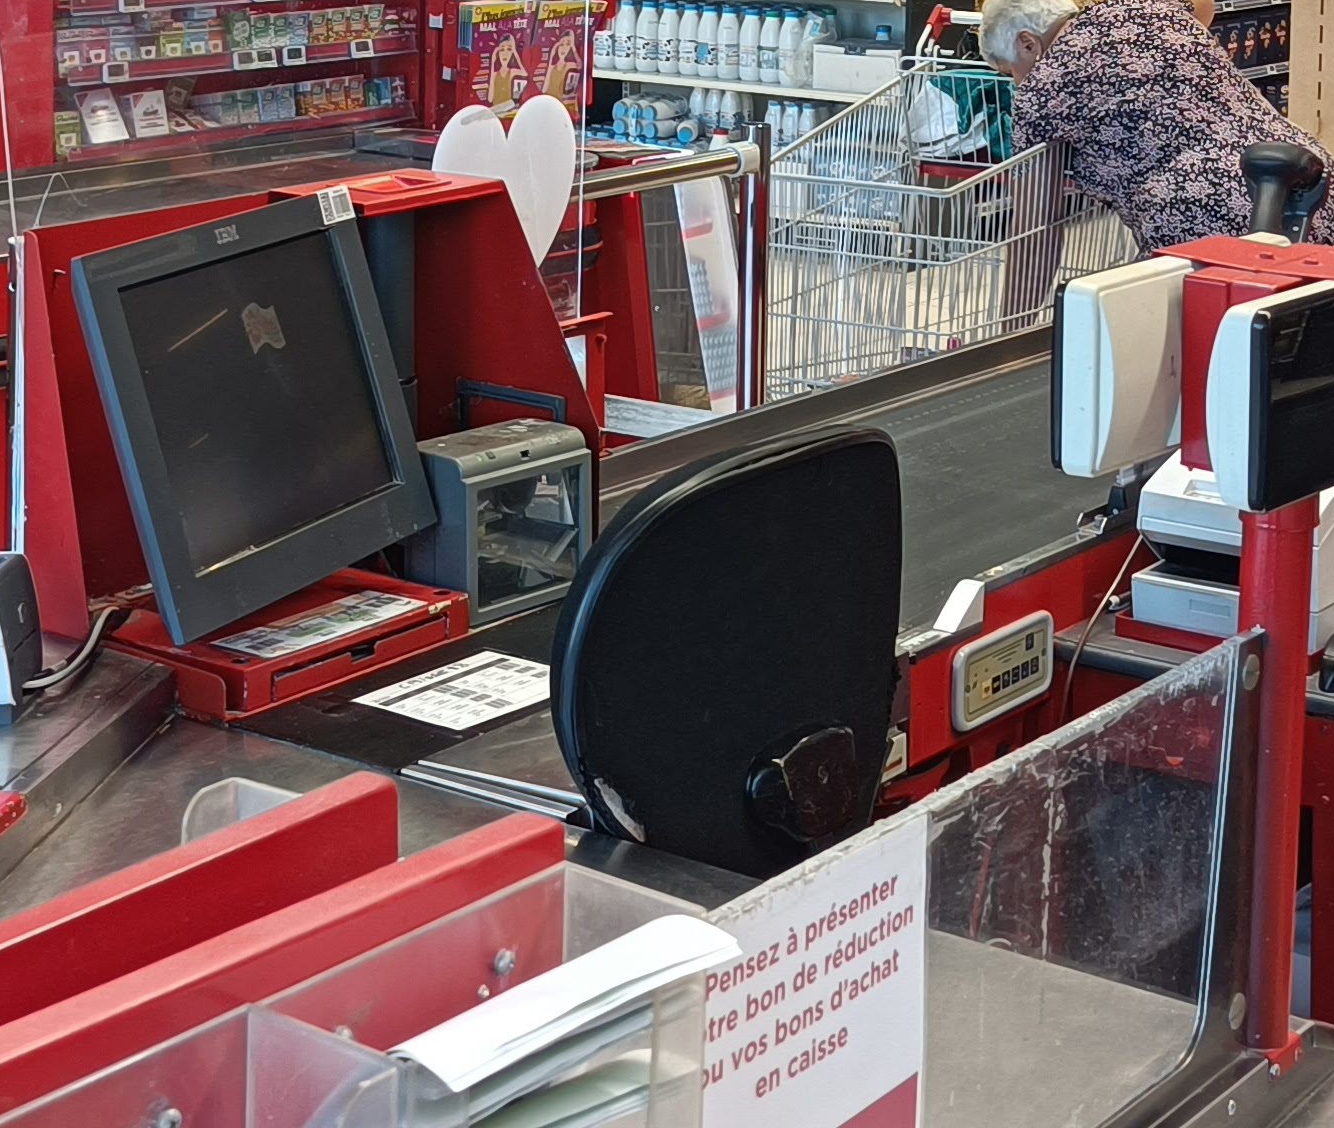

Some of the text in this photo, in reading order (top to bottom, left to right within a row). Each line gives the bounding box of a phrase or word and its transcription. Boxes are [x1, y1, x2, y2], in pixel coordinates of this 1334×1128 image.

[703, 903, 914, 1044] tre bon de réduction
[704, 874, 899, 1002] Pensez à présenter
[730, 1032, 768, 1071] vos
[774, 998, 824, 1047] bons
[830, 948, 900, 1012] d'achat
[755, 1025, 849, 1099] en caisse
